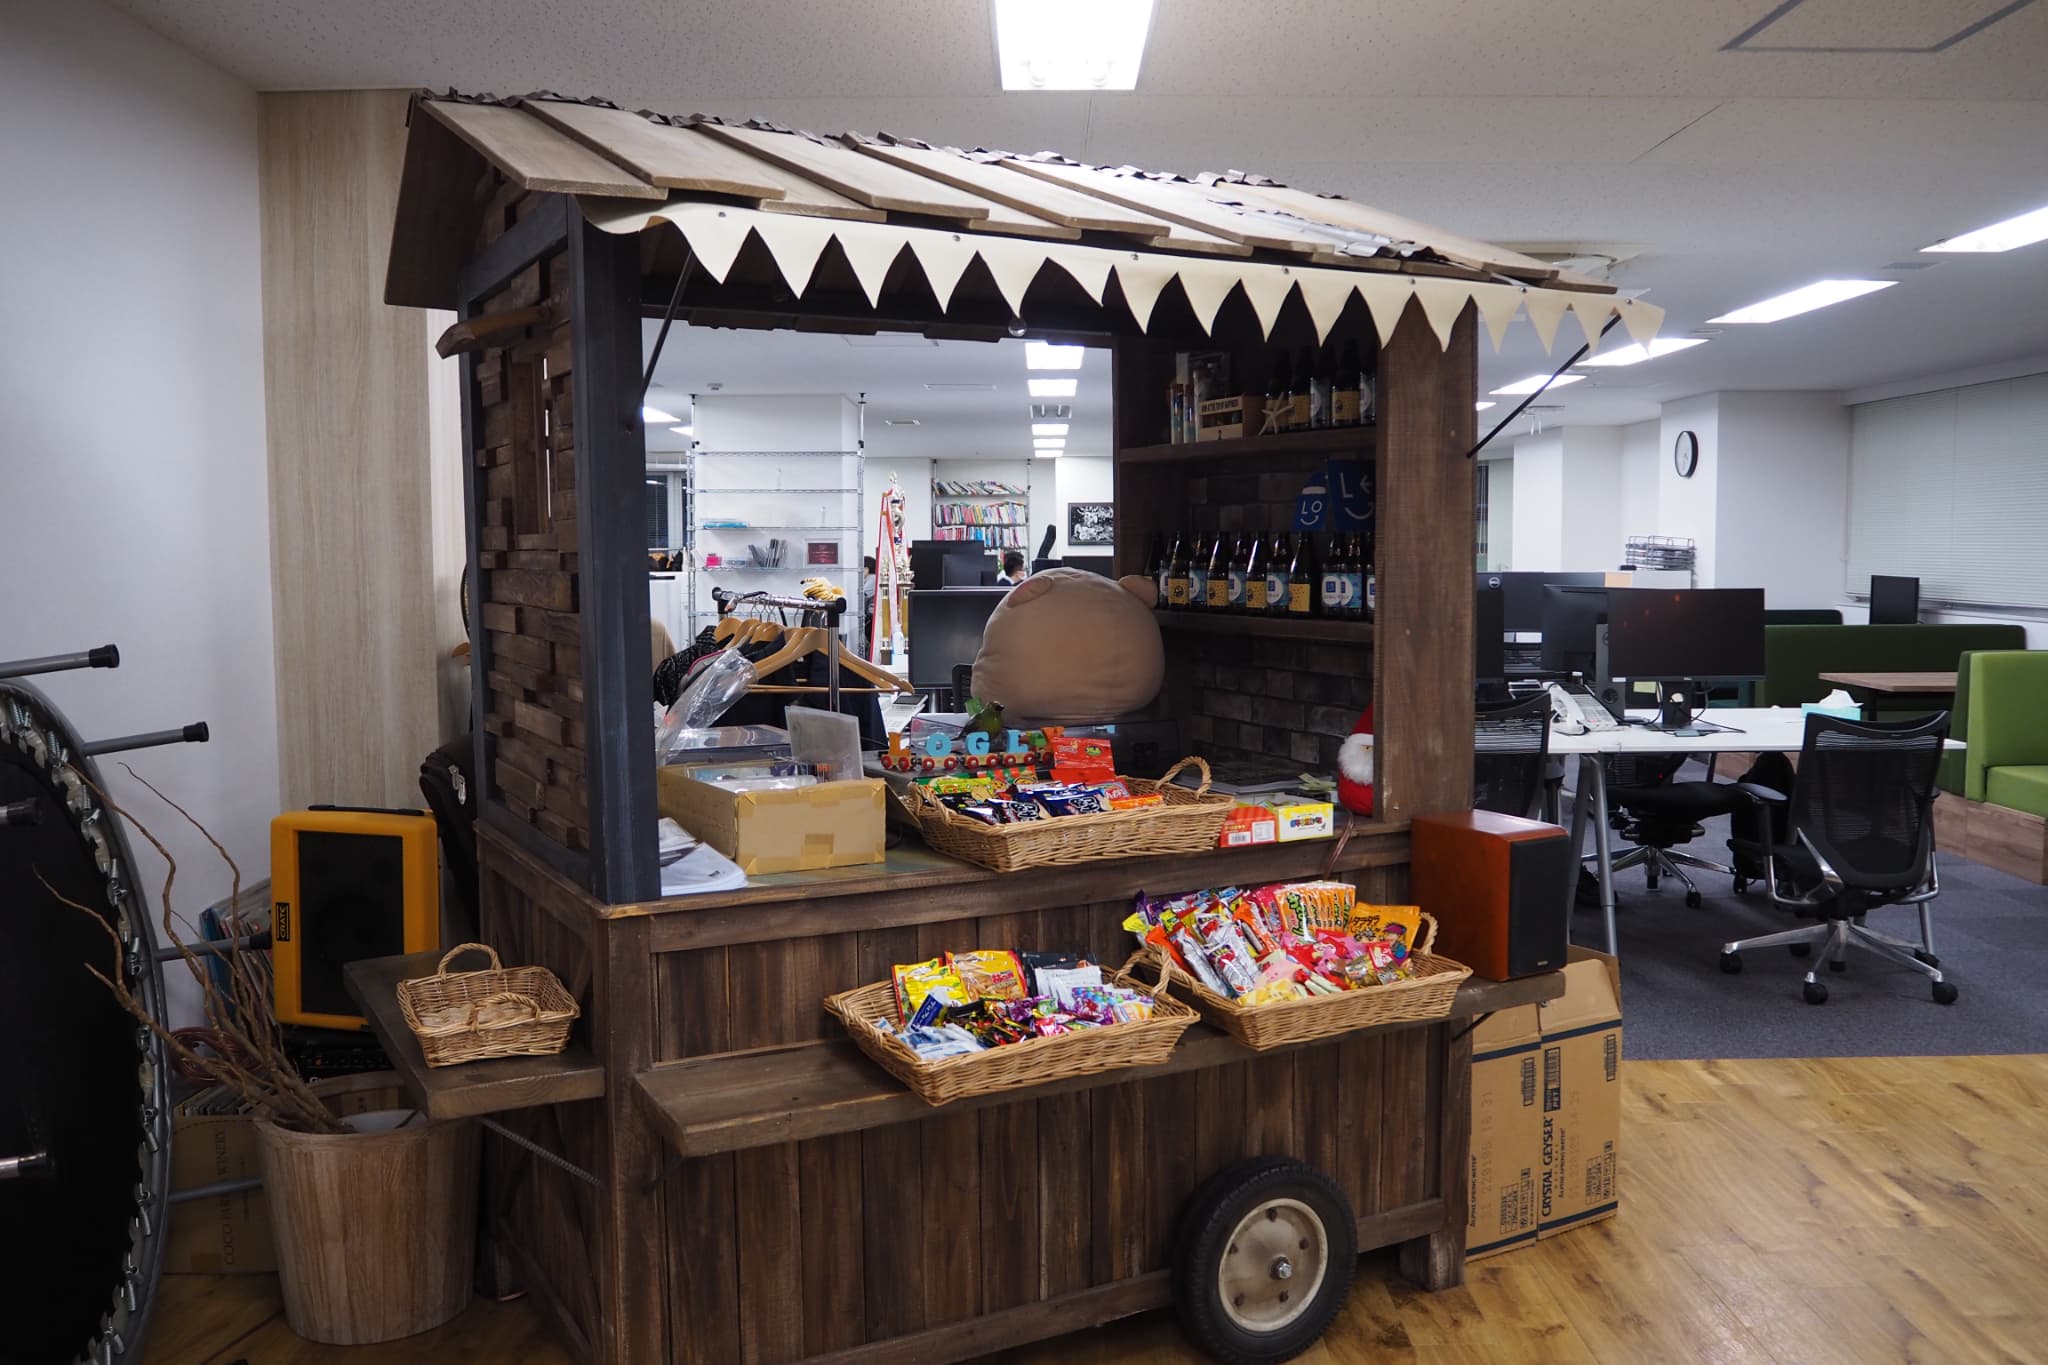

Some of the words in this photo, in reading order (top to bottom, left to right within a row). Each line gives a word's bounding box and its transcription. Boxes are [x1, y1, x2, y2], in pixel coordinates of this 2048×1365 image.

[215, 1130, 227, 1177] WINERY
[1542, 1118, 1554, 1166] GEYSER
[1541, 1169, 1553, 1217] CRYSTAL
